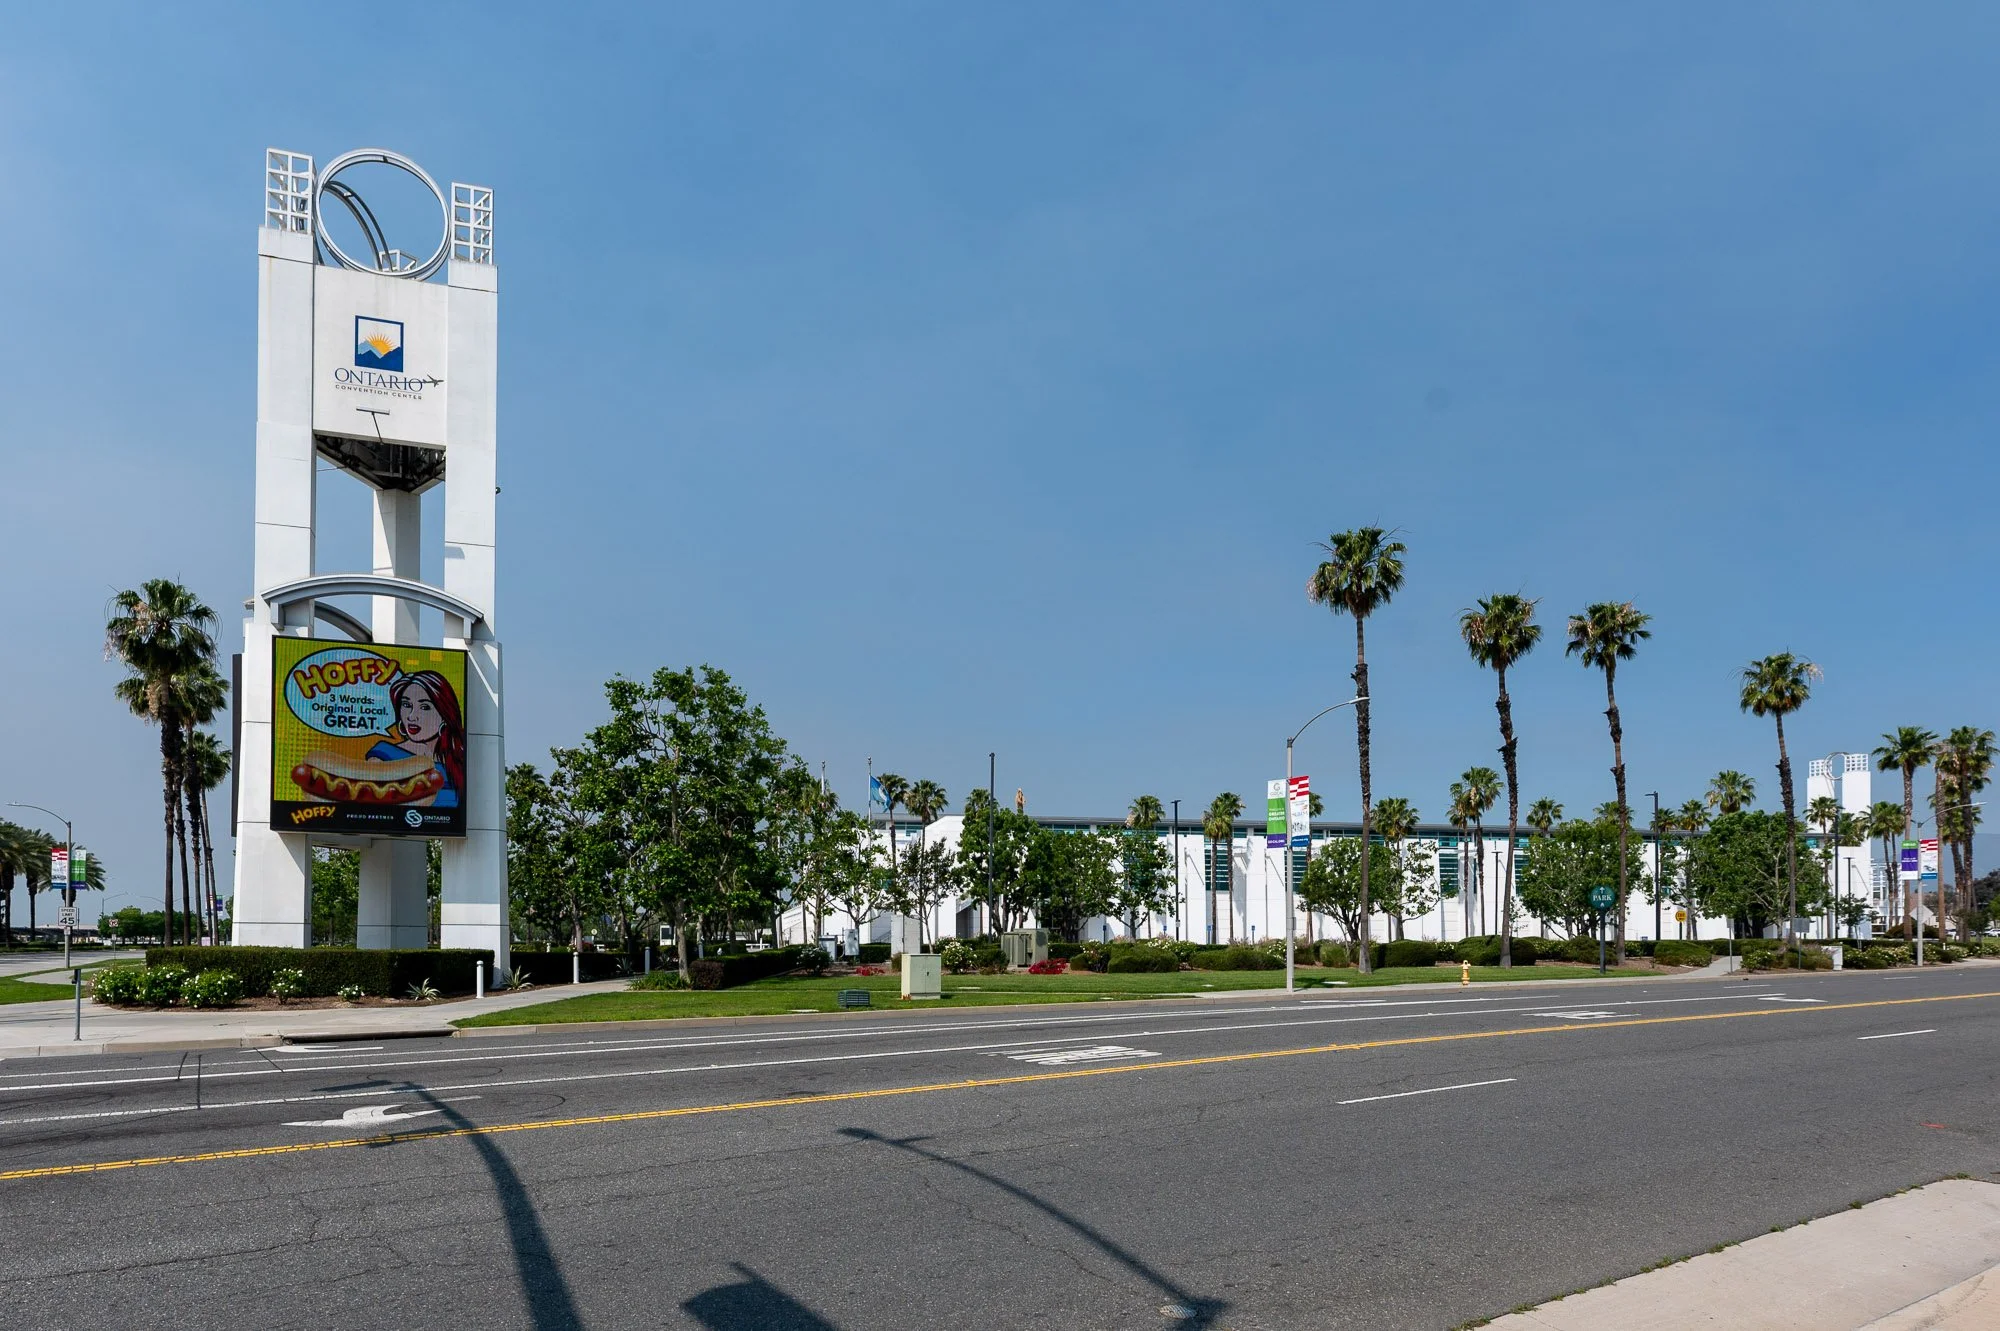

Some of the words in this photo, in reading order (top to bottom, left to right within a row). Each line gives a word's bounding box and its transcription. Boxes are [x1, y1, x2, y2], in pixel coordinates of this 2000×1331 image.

[334, 367, 423, 392] ONTARIO
[335, 384, 389, 396] CONVENTION
[391, 392, 422, 400] CENTER
[293, 657, 400, 699] HOFFY
[329, 693, 336, 702] 3
[339, 694, 375, 705] Words:
[311, 702, 356, 716] Original.
[360, 705, 389, 716] Local.
[324, 714, 380, 730] GREAT.
[290, 806, 336, 825] HOFFY
